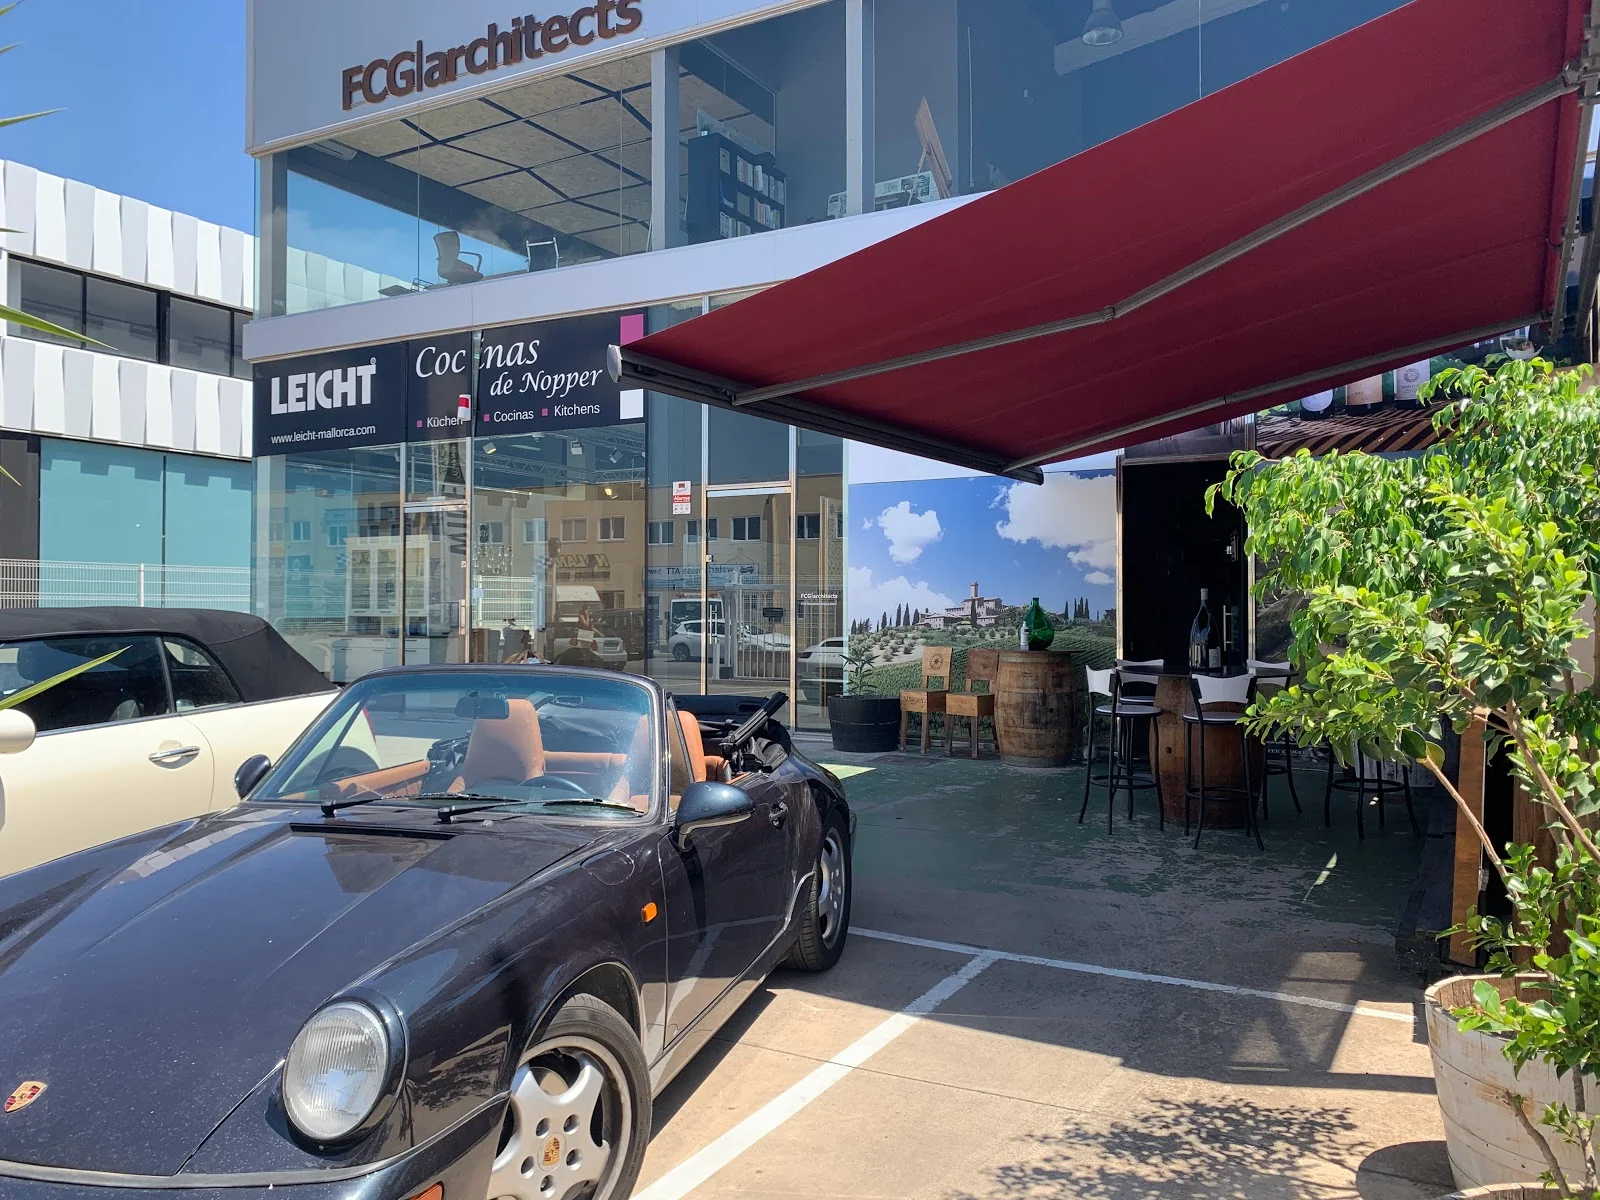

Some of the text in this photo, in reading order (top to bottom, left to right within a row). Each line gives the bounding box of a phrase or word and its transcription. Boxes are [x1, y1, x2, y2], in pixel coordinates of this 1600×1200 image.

[490, 369, 603, 398] de Nopper
[427, 404, 600, 428] Küchen Cocinas Kitchens
[271, 424, 376, 444] www.leicht-mallorca.com
